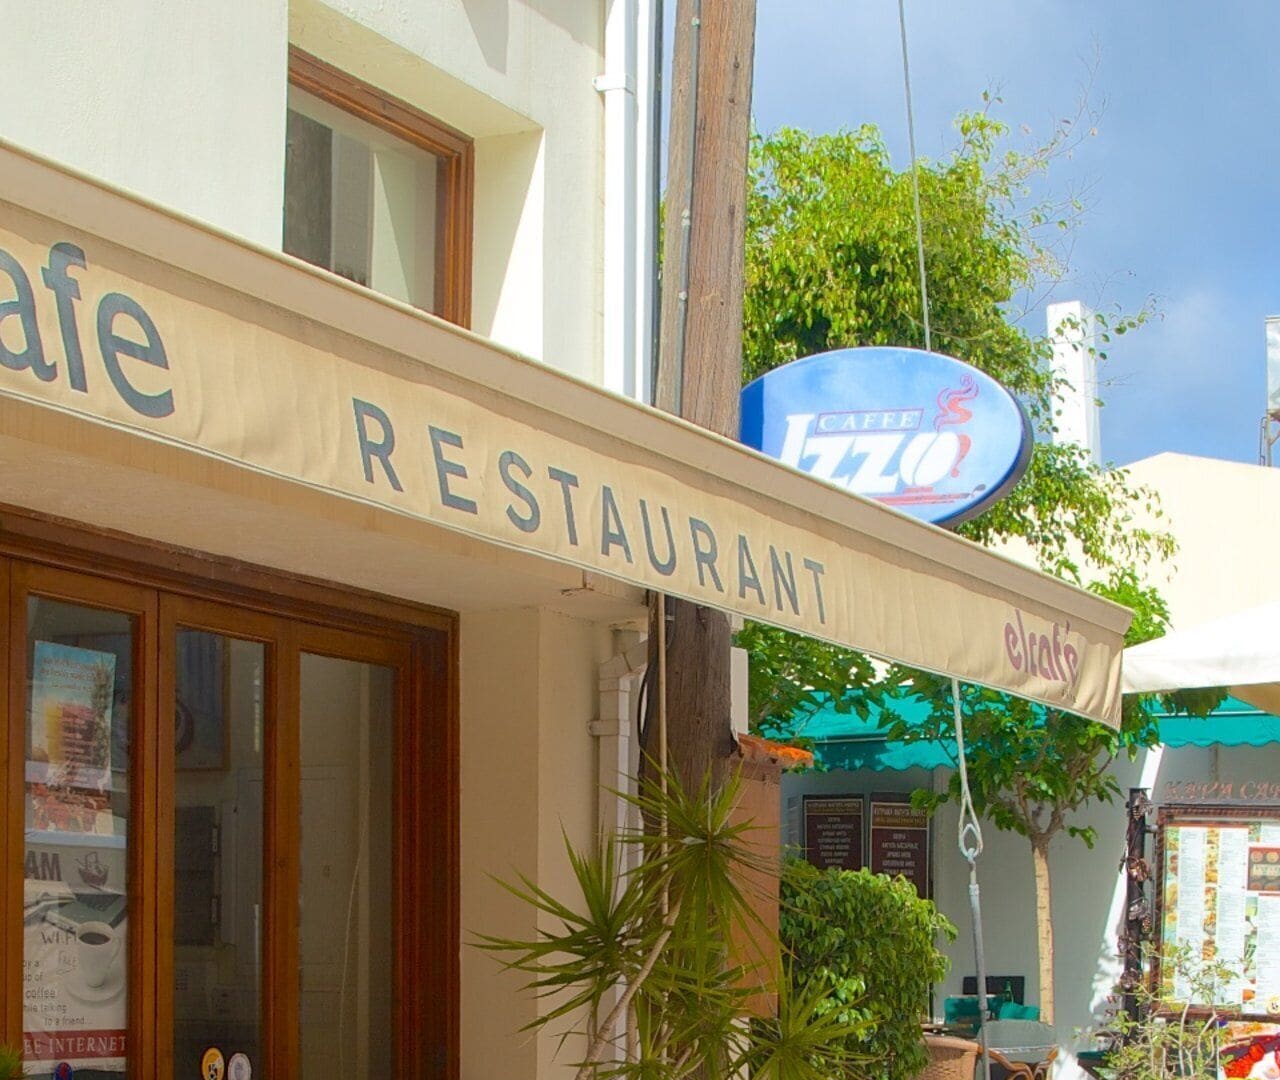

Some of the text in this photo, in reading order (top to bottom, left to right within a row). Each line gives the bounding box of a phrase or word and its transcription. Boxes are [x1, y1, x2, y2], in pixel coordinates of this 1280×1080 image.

[353, 397, 826, 624] RESTAURANT
[26, 987, 56, 998] coffee
[49, 1035, 126, 1054] INTERNET
